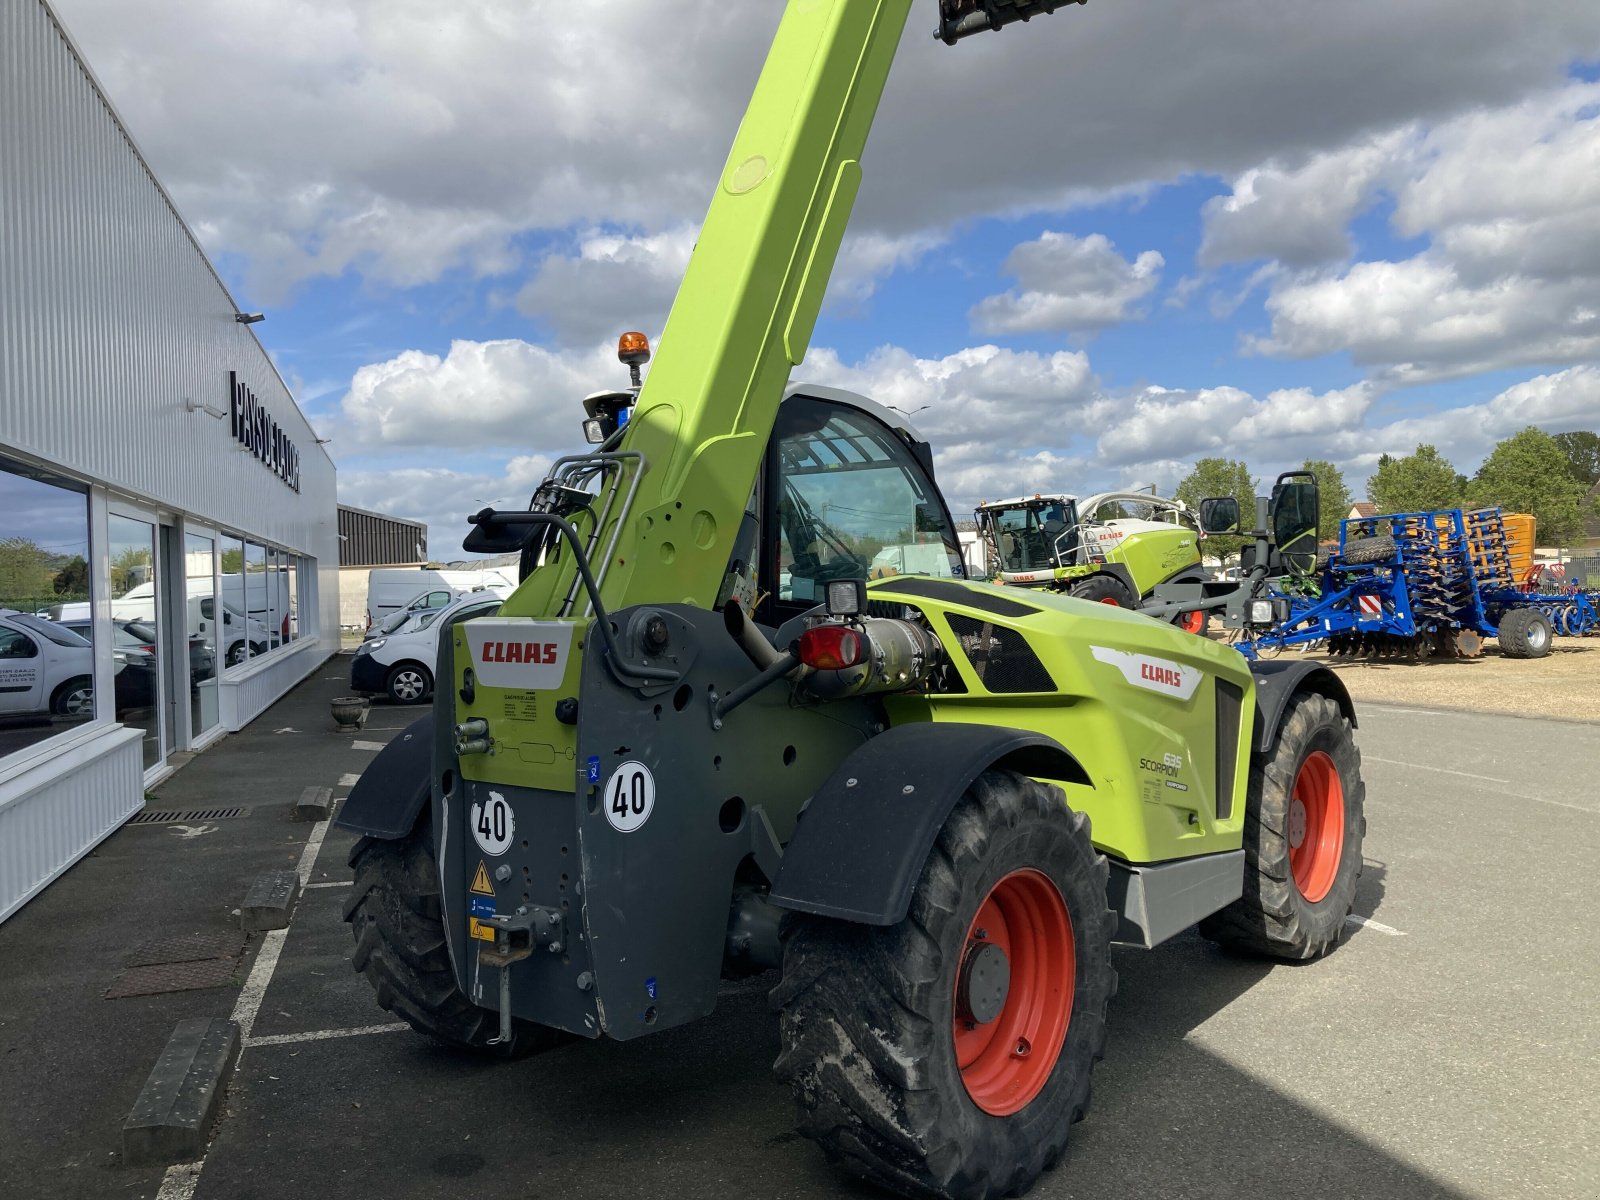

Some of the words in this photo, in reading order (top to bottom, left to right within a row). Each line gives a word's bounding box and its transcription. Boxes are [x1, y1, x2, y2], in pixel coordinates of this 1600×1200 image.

[1099, 531, 1123, 541] CLAAS
[482, 642, 558, 664] CLAAS
[1141, 663, 1181, 688] CLAAS
[1139, 758, 1178, 778] SCORPION
[1164, 752, 1183, 769] 635
[613, 771, 645, 817] 40
[478, 801, 505, 842] 40
